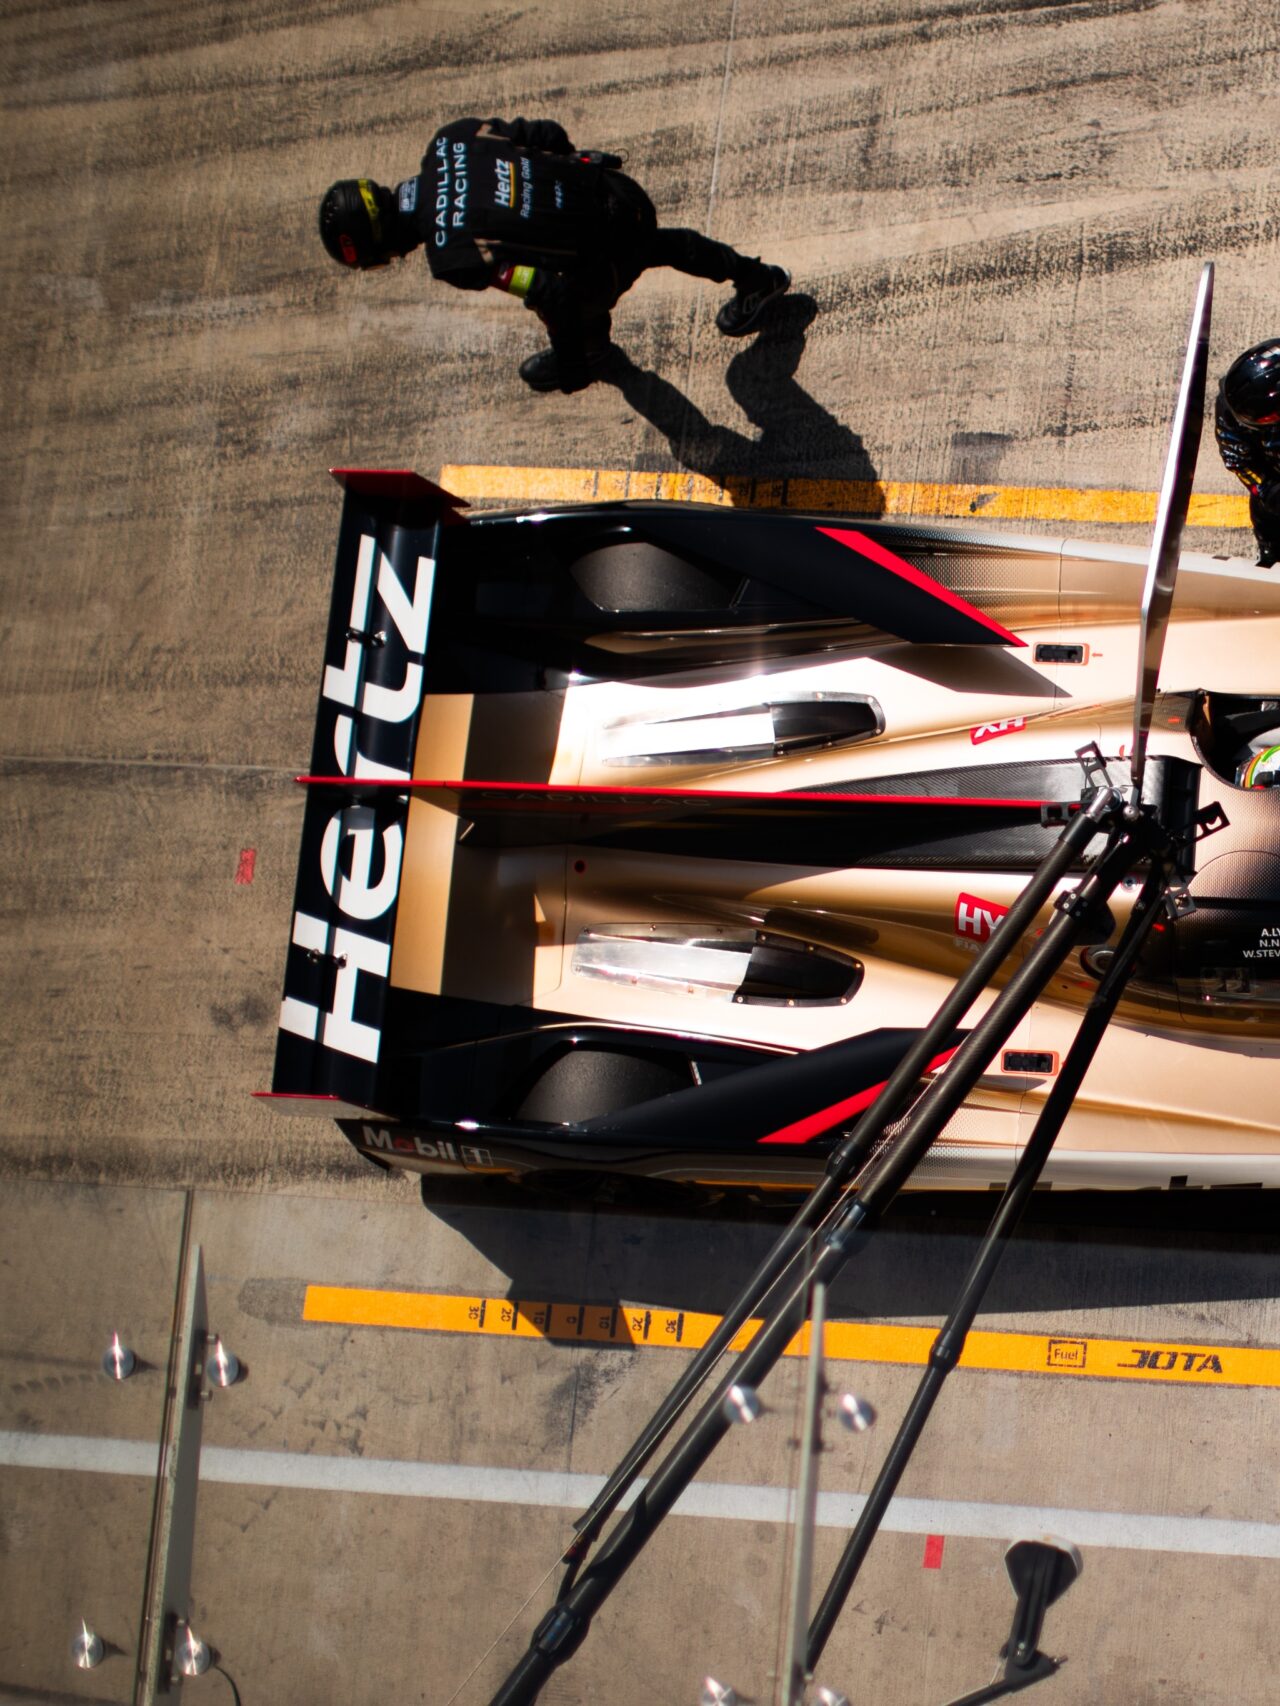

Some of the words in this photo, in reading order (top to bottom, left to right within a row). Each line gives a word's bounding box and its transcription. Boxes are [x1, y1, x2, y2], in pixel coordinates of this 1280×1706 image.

[520, 157, 531, 180] Gold
[436, 137, 448, 246] CADILLAC
[453, 142, 468, 227] RACING
[494, 158, 511, 207] Hertz
[520, 183, 533, 218] Racing
[279, 534, 435, 1063] Hertz
[362, 1125, 458, 1161] Mobil
[469, 1306, 480, 1319] 30
[501, 1308, 512, 1322] 20
[534, 1312, 545, 1324] 10
[567, 1316, 577, 1324] 0
[600, 1316, 610, 1329] 10
[632, 1317, 643, 1332] 20
[666, 1320, 677, 1334] 30
[1054, 1348, 1079, 1361] Fuel
[1117, 1350, 1223, 1373] JOTA
